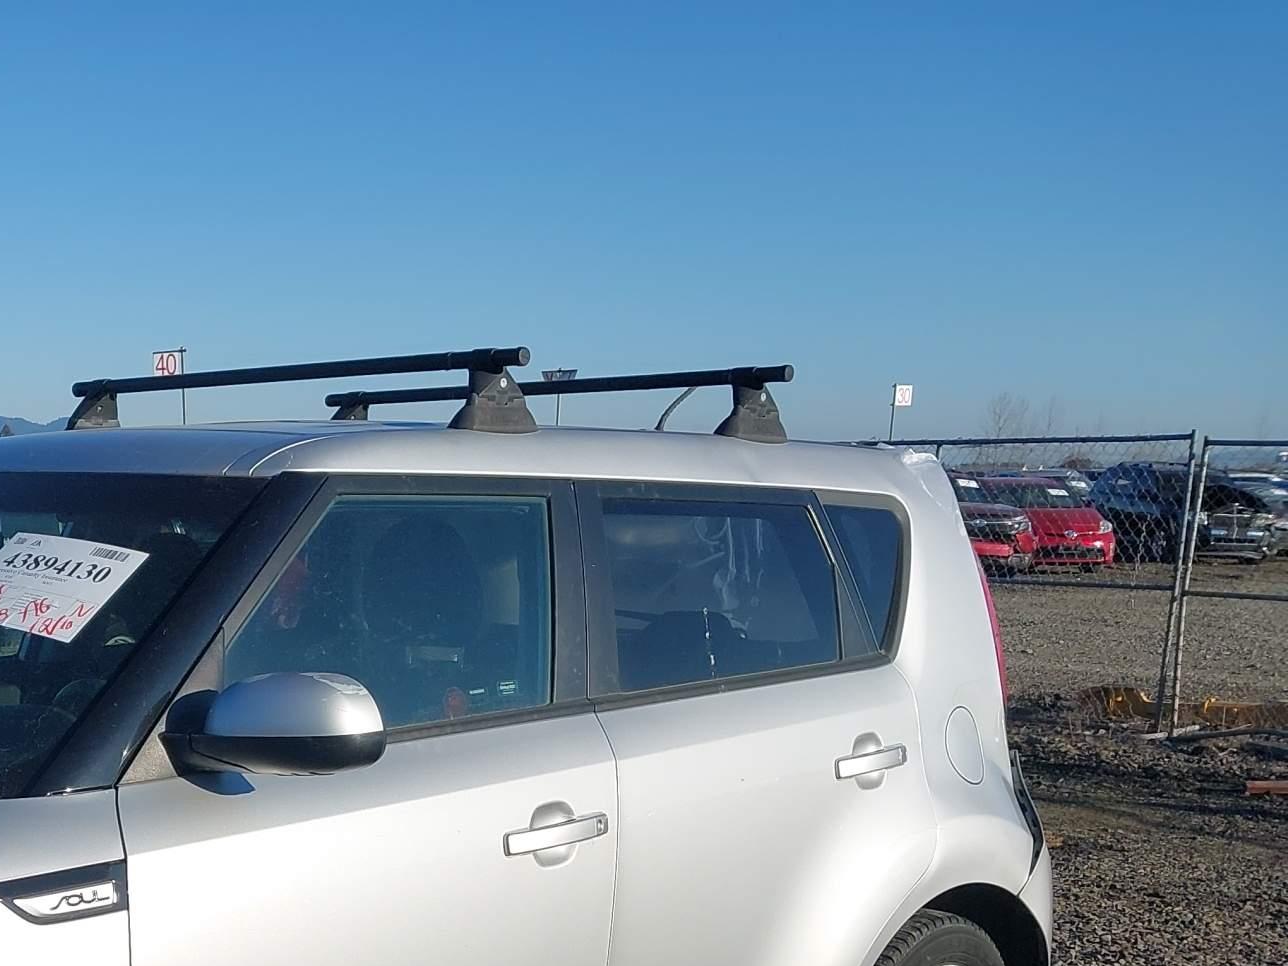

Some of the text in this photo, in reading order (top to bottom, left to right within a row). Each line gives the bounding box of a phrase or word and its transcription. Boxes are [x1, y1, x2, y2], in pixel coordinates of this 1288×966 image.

[155, 353, 177, 376] 40
[897, 387, 911, 404] 30
[3, 551, 112, 583] 43894130
[49, 889, 110, 911] SOUL
